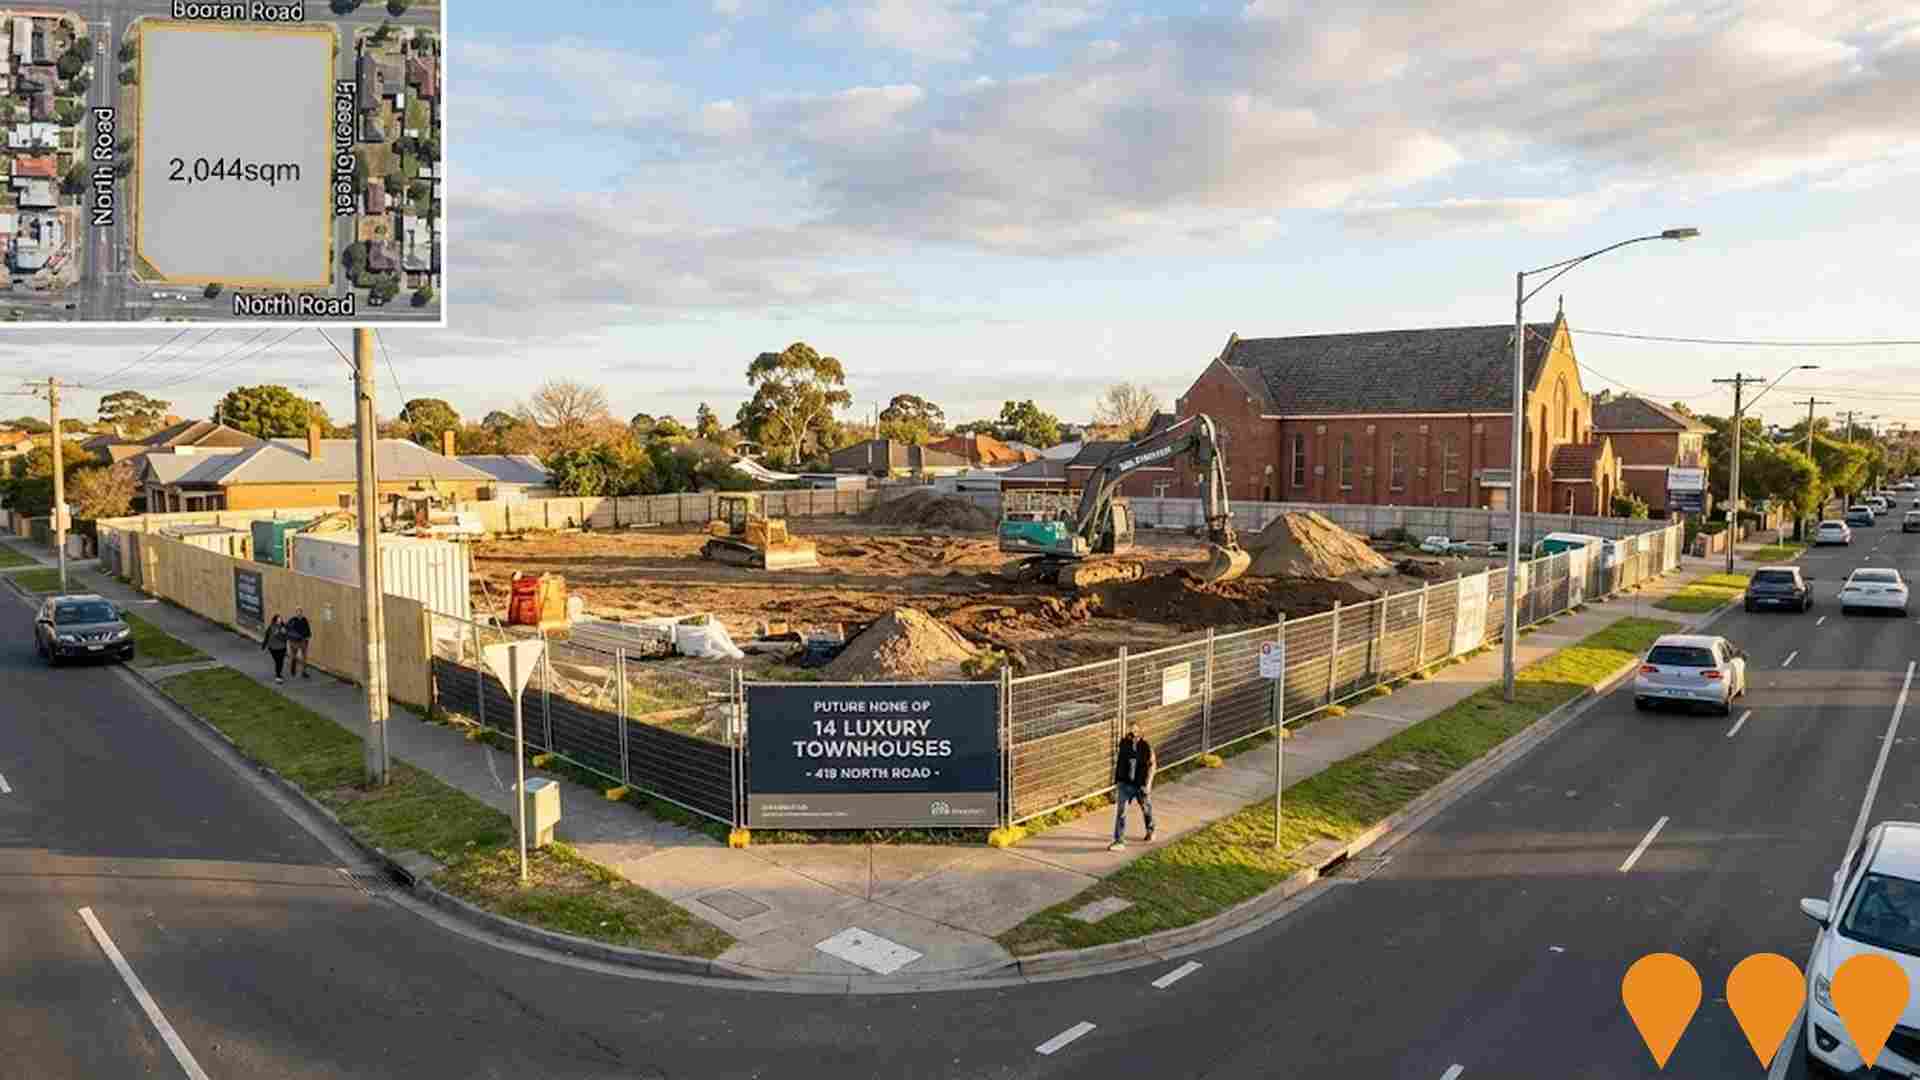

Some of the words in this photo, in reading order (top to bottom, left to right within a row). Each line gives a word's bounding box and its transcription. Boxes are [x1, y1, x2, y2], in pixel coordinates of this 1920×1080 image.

[813, 719, 837, 737] 14
[844, 719, 931, 737] LUXURY
[793, 740, 952, 758] TOWNHOUSES
[841, 767, 889, 779] NORTH
